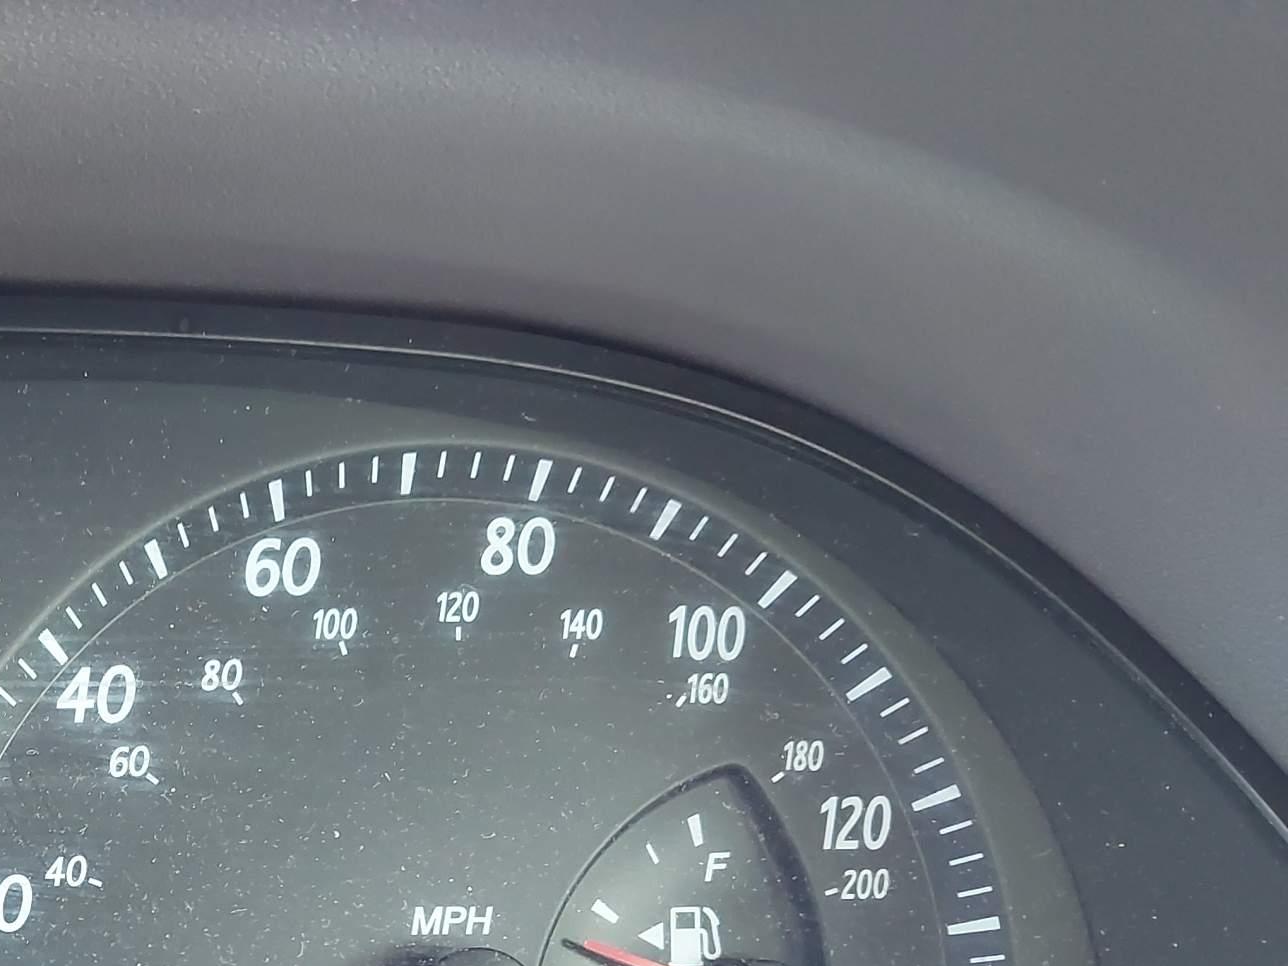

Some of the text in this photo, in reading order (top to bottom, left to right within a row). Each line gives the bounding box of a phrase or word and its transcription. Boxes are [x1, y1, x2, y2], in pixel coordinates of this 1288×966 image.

[479, 516, 555, 576] 80
[244, 537, 321, 597] 60
[436, 591, 479, 623] 120
[313, 608, 358, 641] 100
[560, 608, 603, 641] 140
[668, 605, 745, 661] 100
[200, 658, 243, 692] 80
[687, 673, 729, 705] 160
[56, 665, 137, 723] 40
[109, 745, 150, 778] 60
[783, 739, 824, 771] 180
[819, 795, 892, 851] 120
[44, 855, 88, 887] 40
[704, 852, 731, 882] F
[840, 869, 890, 901] 200
[411, 906, 493, 936] MPH
